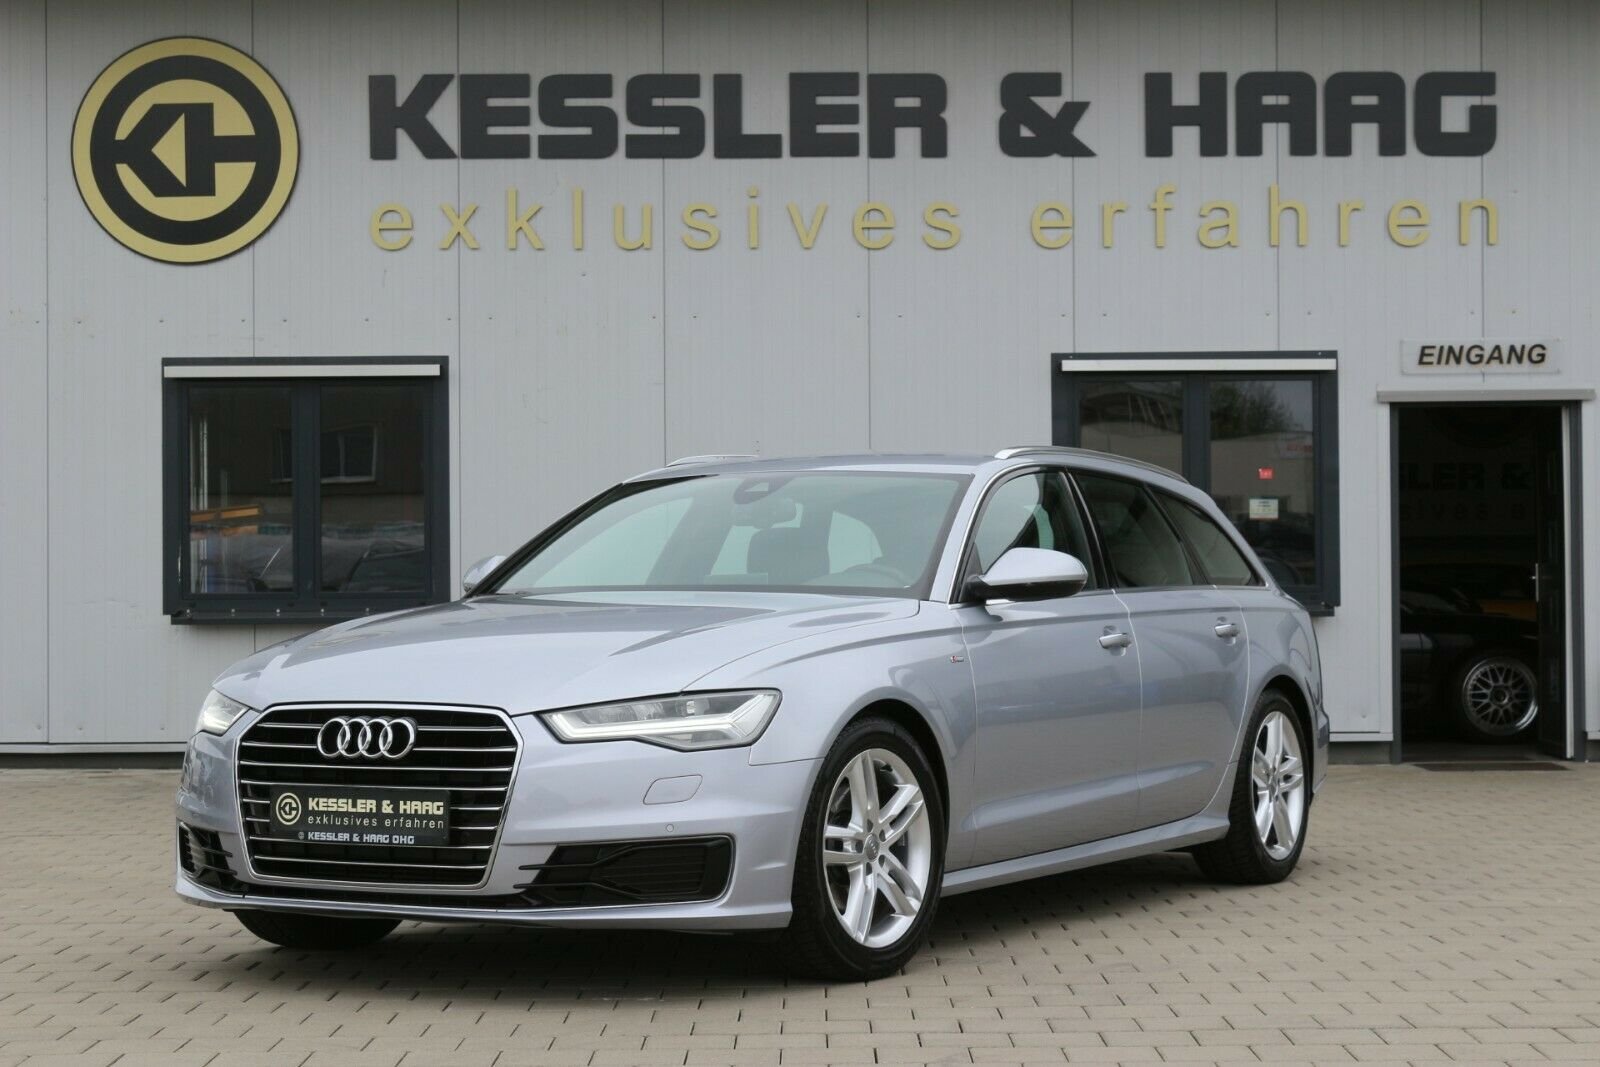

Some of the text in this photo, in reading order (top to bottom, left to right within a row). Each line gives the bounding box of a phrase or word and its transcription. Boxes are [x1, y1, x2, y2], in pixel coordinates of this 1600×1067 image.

[369, 71, 1497, 160] KESSLER & HAAG
[370, 185, 1499, 251] exklusives erfahren
[1417, 344, 1548, 366] EINGANG
[308, 797, 444, 815] KESSLER & HAAG
[307, 814, 444, 829] exklusives erfahren
[307, 831, 350, 842] KESSLER
[352, 833, 361, 842] &
[363, 833, 389, 843] HAAG
